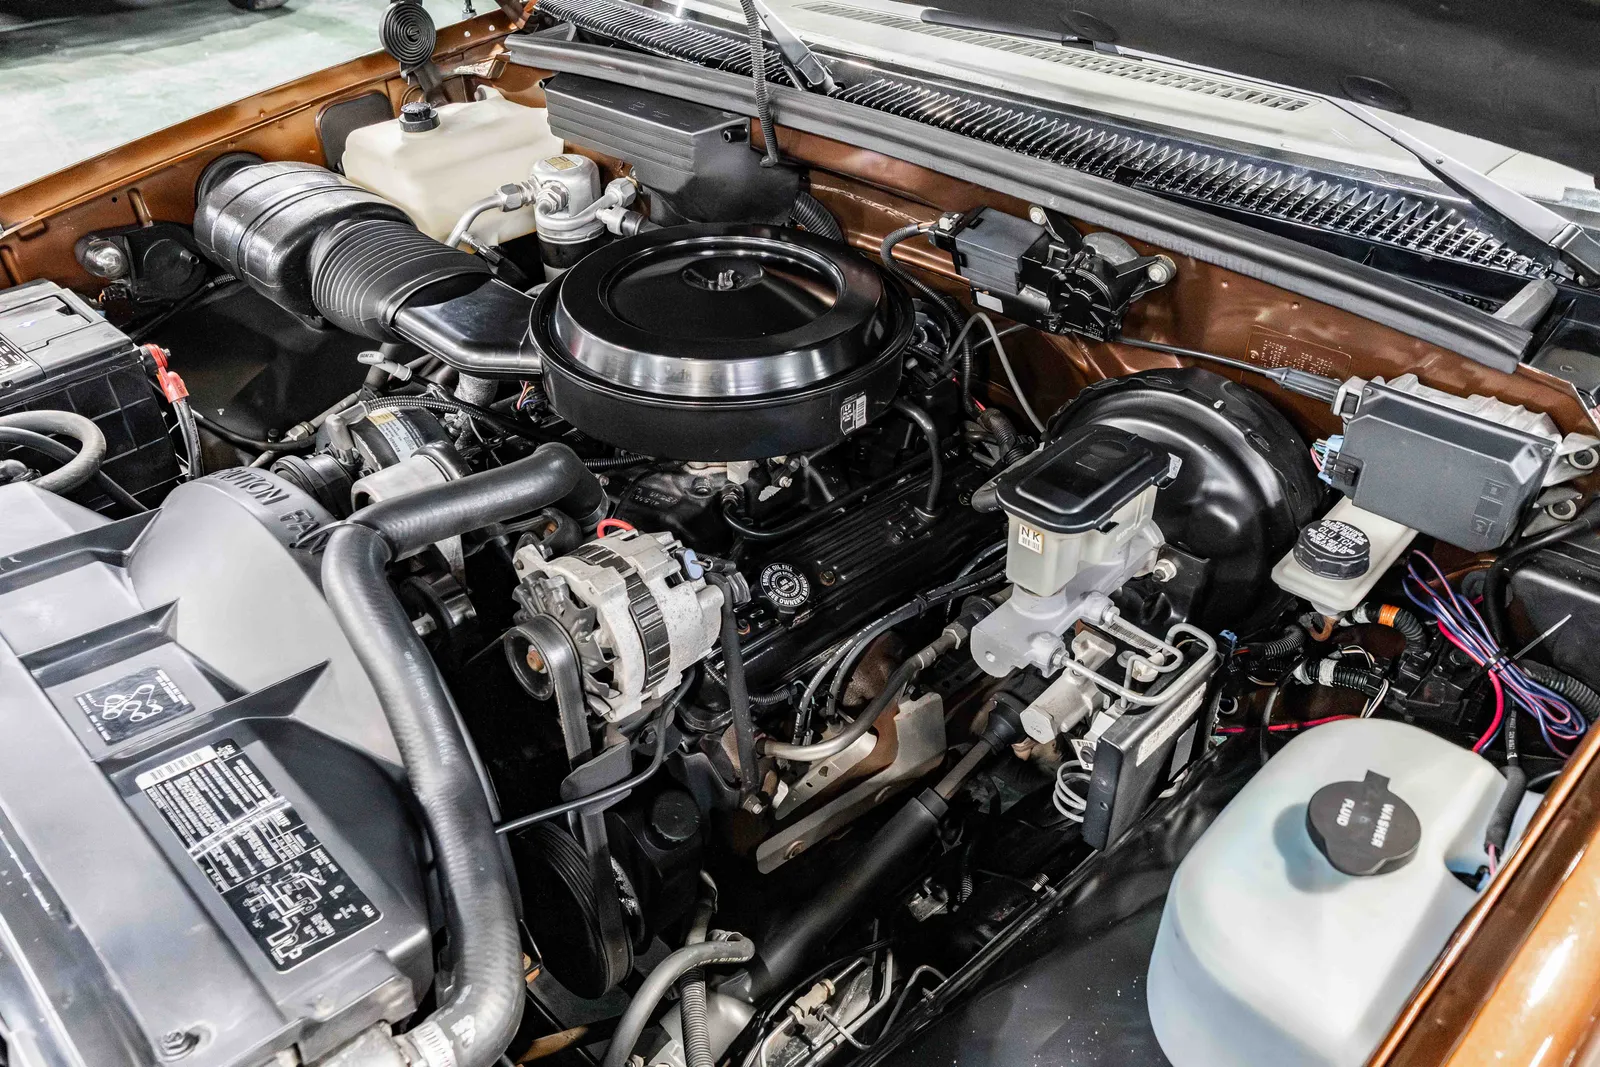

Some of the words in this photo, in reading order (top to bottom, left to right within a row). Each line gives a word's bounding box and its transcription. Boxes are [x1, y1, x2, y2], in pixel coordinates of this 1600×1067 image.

[782, 564, 793, 572] FILL
[1336, 798, 1355, 827] FLUID
[1371, 803, 1395, 848] WASHER
[361, 904, 375, 918] CAM
